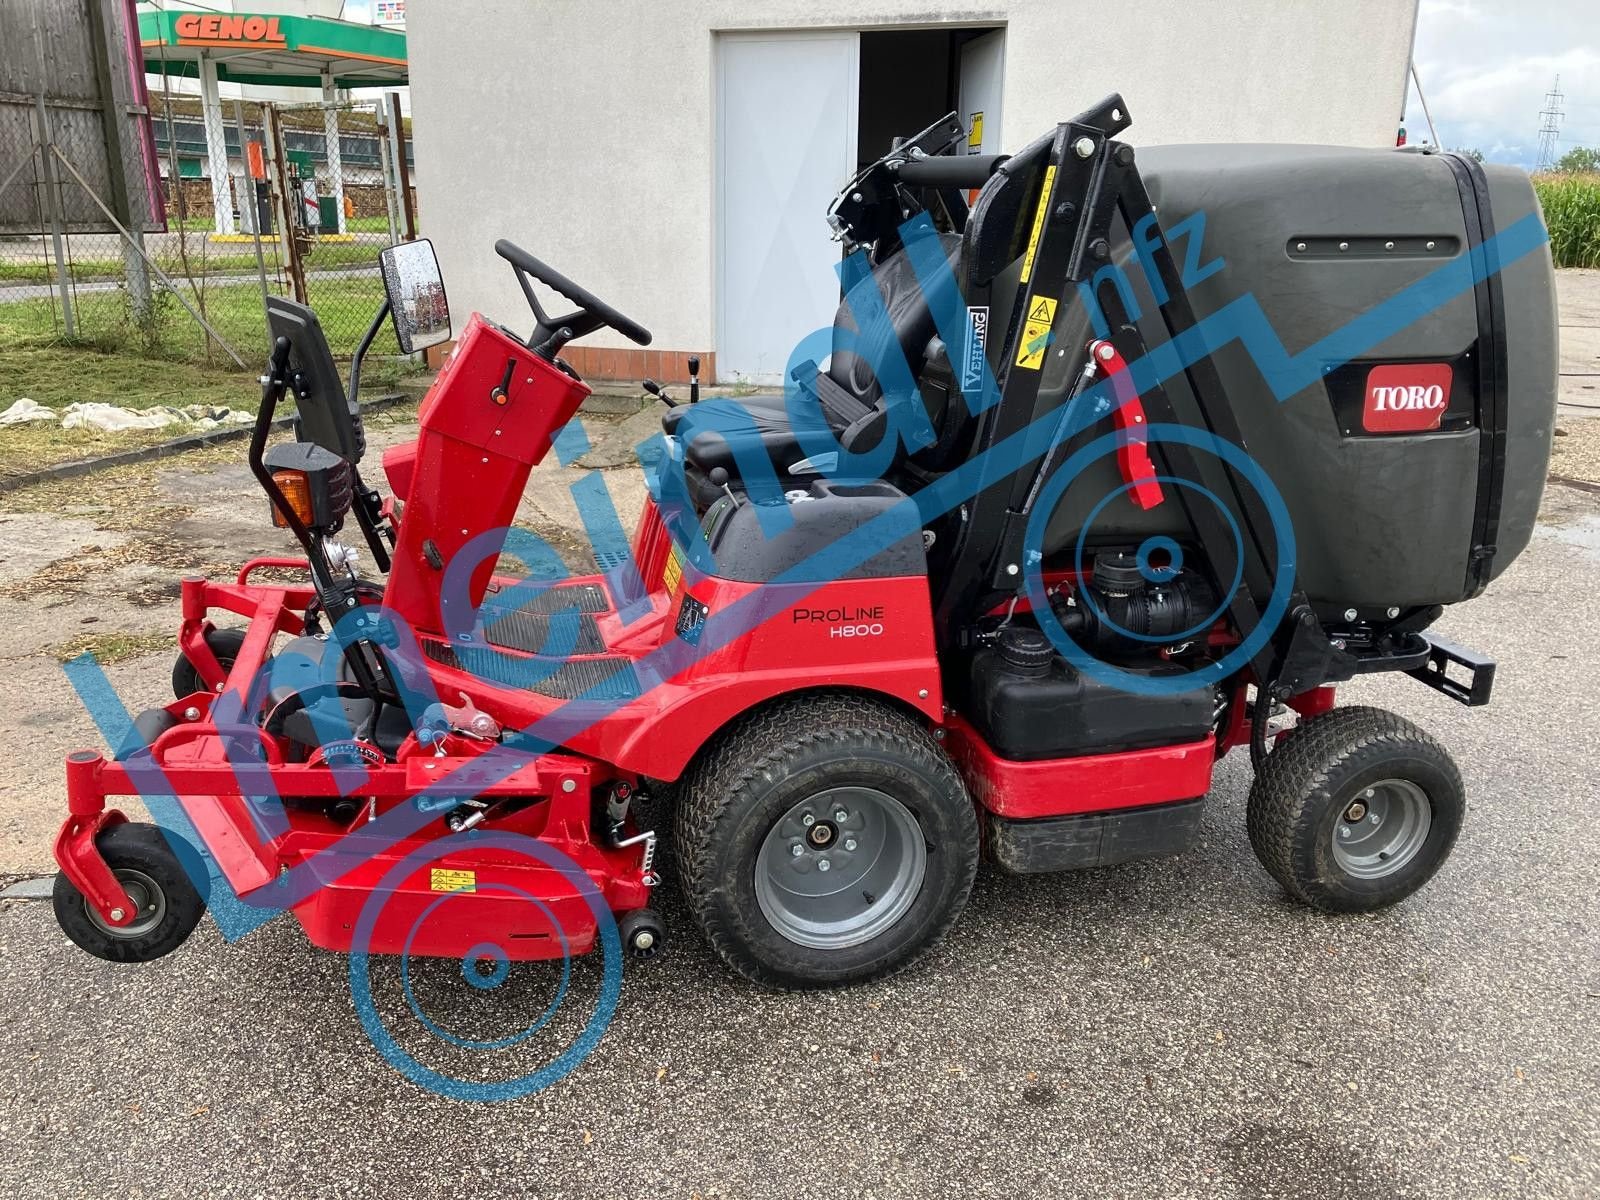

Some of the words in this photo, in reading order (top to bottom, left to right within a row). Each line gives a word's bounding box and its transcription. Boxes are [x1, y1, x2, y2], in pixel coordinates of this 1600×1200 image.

[175, 13, 286, 42] GENOL
[1372, 384, 1444, 411] TORO
[830, 623, 884, 638] H800
